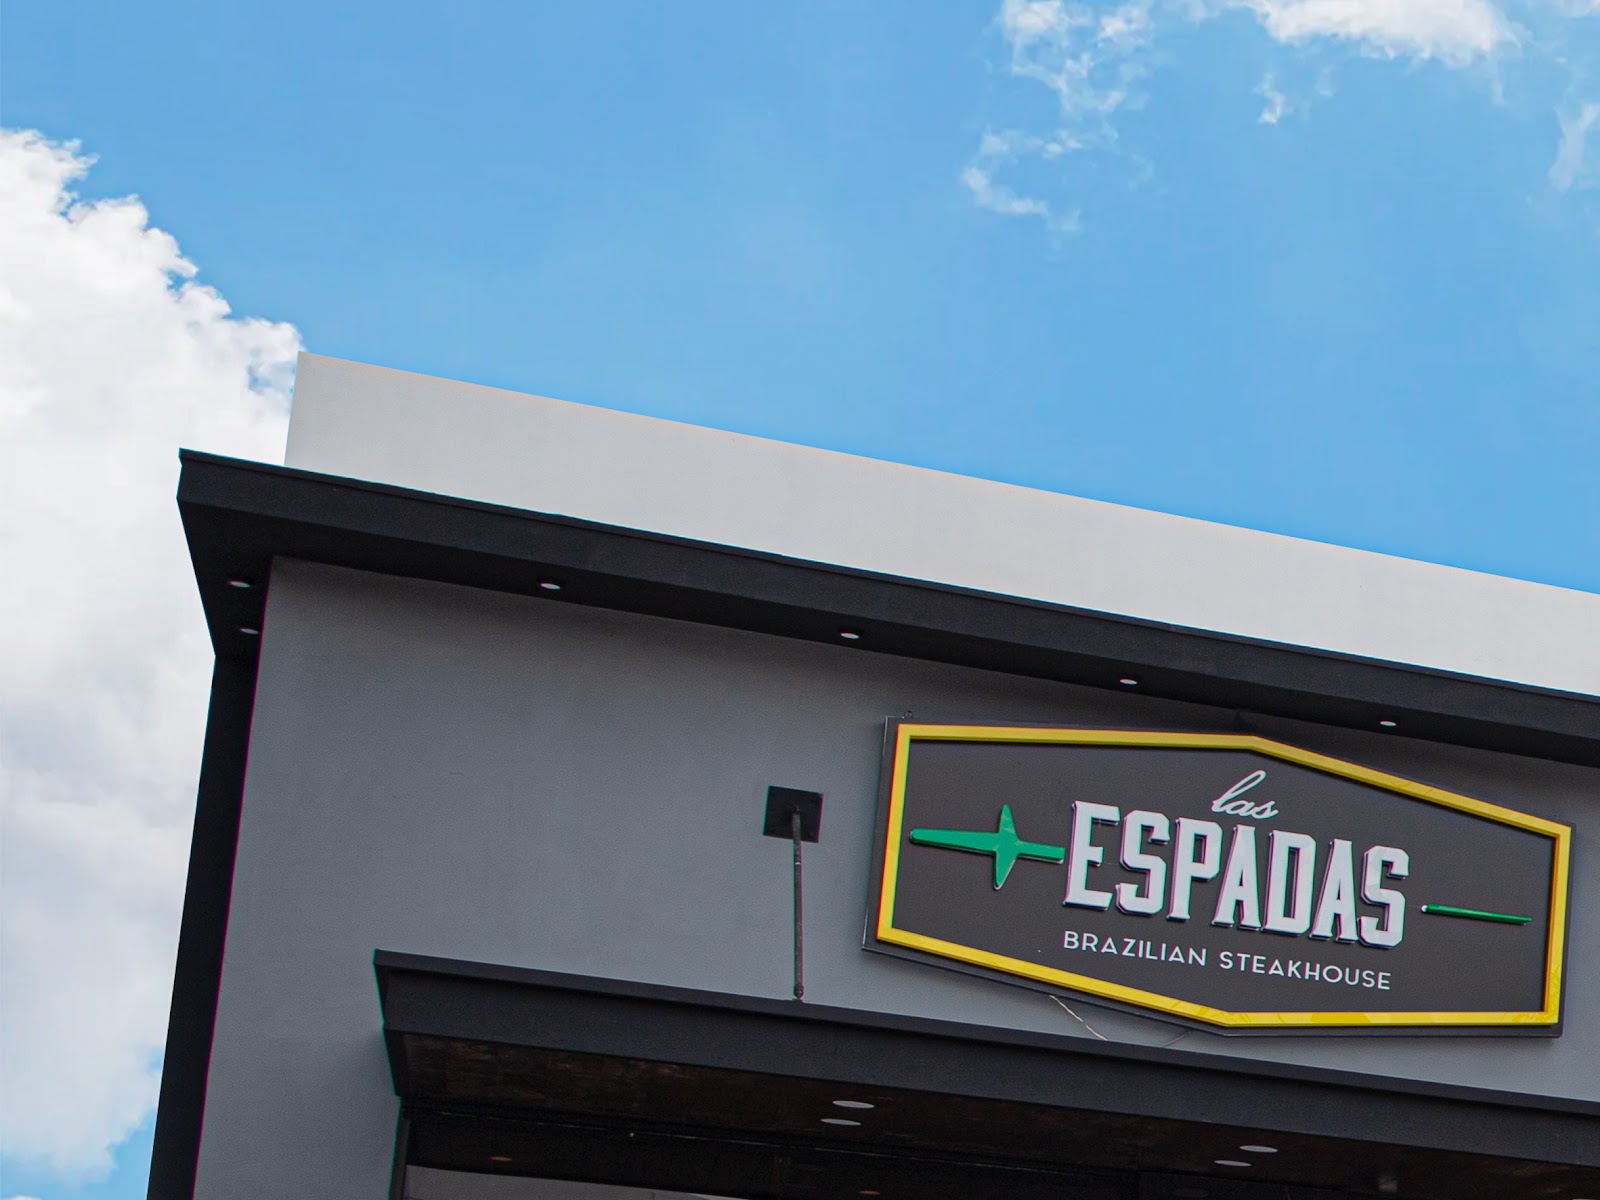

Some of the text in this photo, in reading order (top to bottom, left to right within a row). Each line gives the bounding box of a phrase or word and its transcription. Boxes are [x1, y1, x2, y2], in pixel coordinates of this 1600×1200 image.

[1212, 770, 1279, 819] las
[1063, 800, 1410, 948] ESPADAS
[1063, 930, 1392, 990] BRAZILIAN STEAKHOUSE
